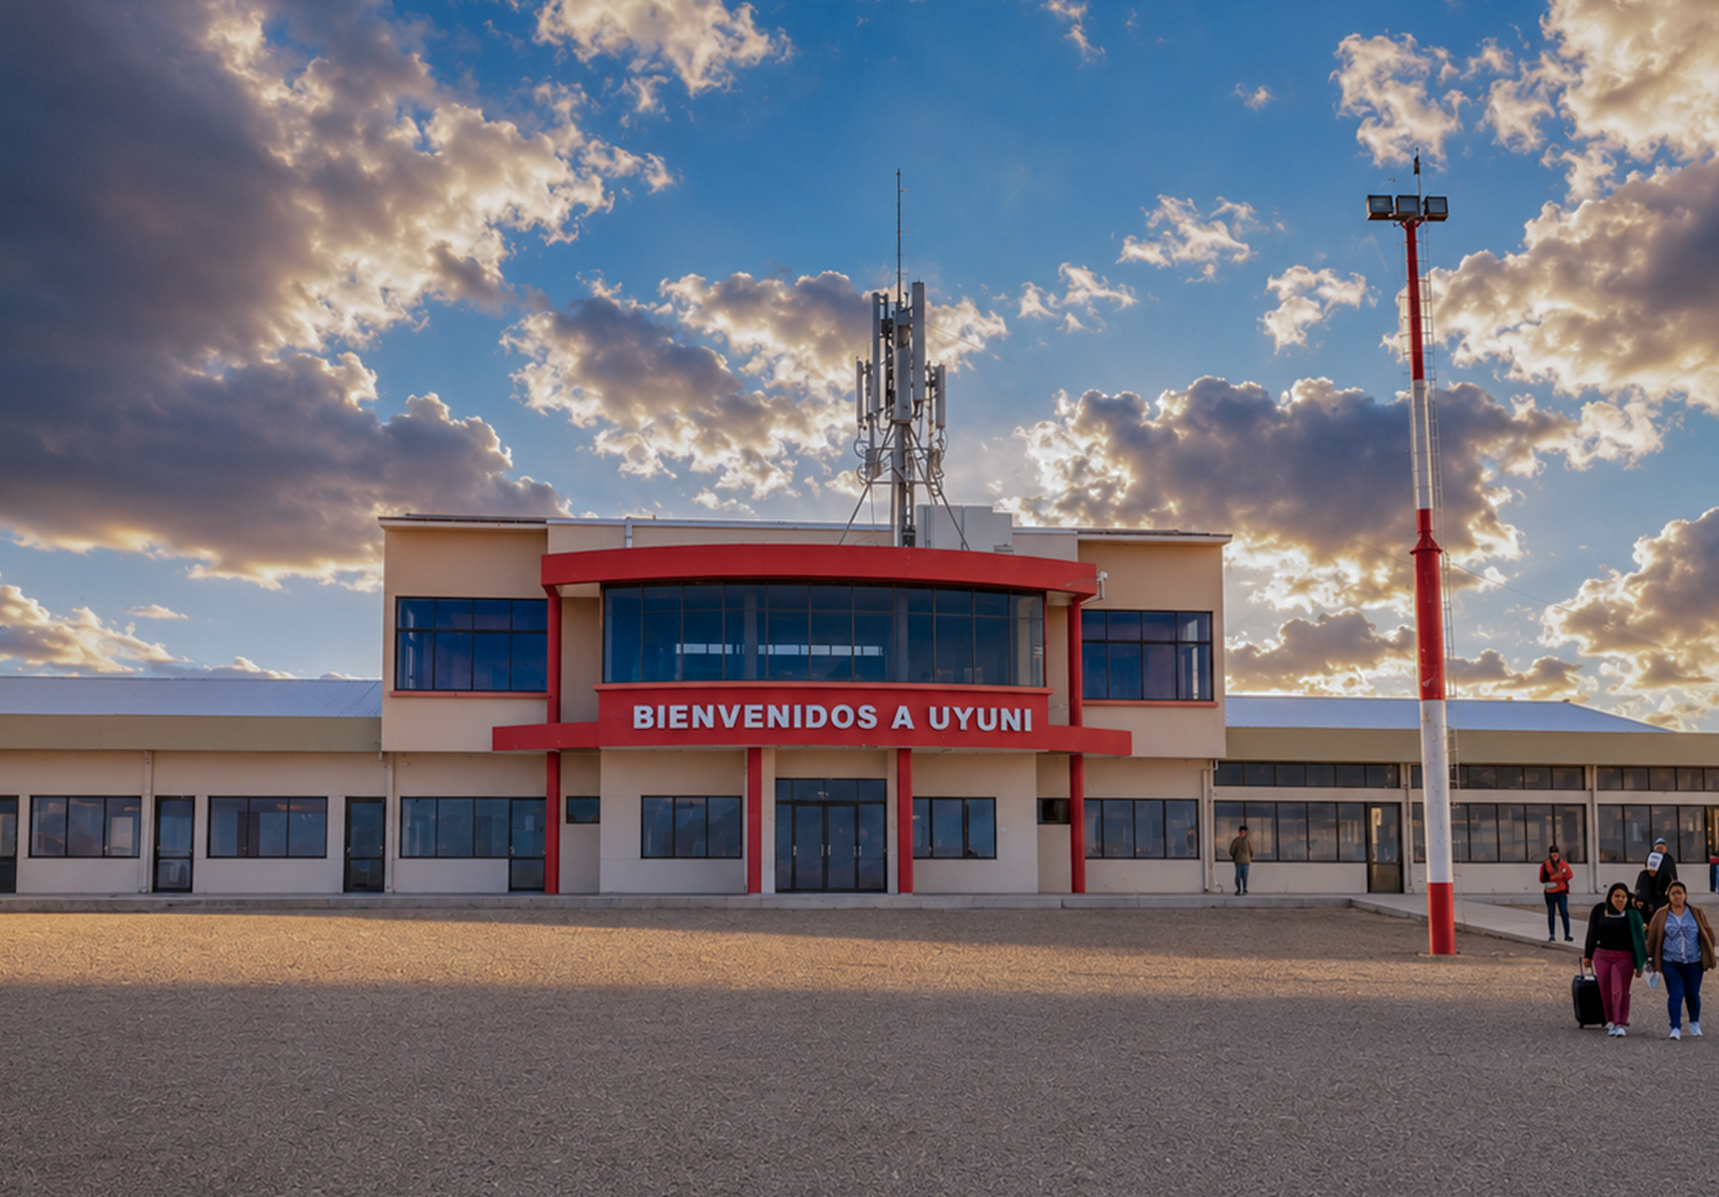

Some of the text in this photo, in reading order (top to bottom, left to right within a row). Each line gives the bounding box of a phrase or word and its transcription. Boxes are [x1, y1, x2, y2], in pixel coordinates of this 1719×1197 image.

[633, 704, 1033, 732] BIENVENIDOS A UYUNI
